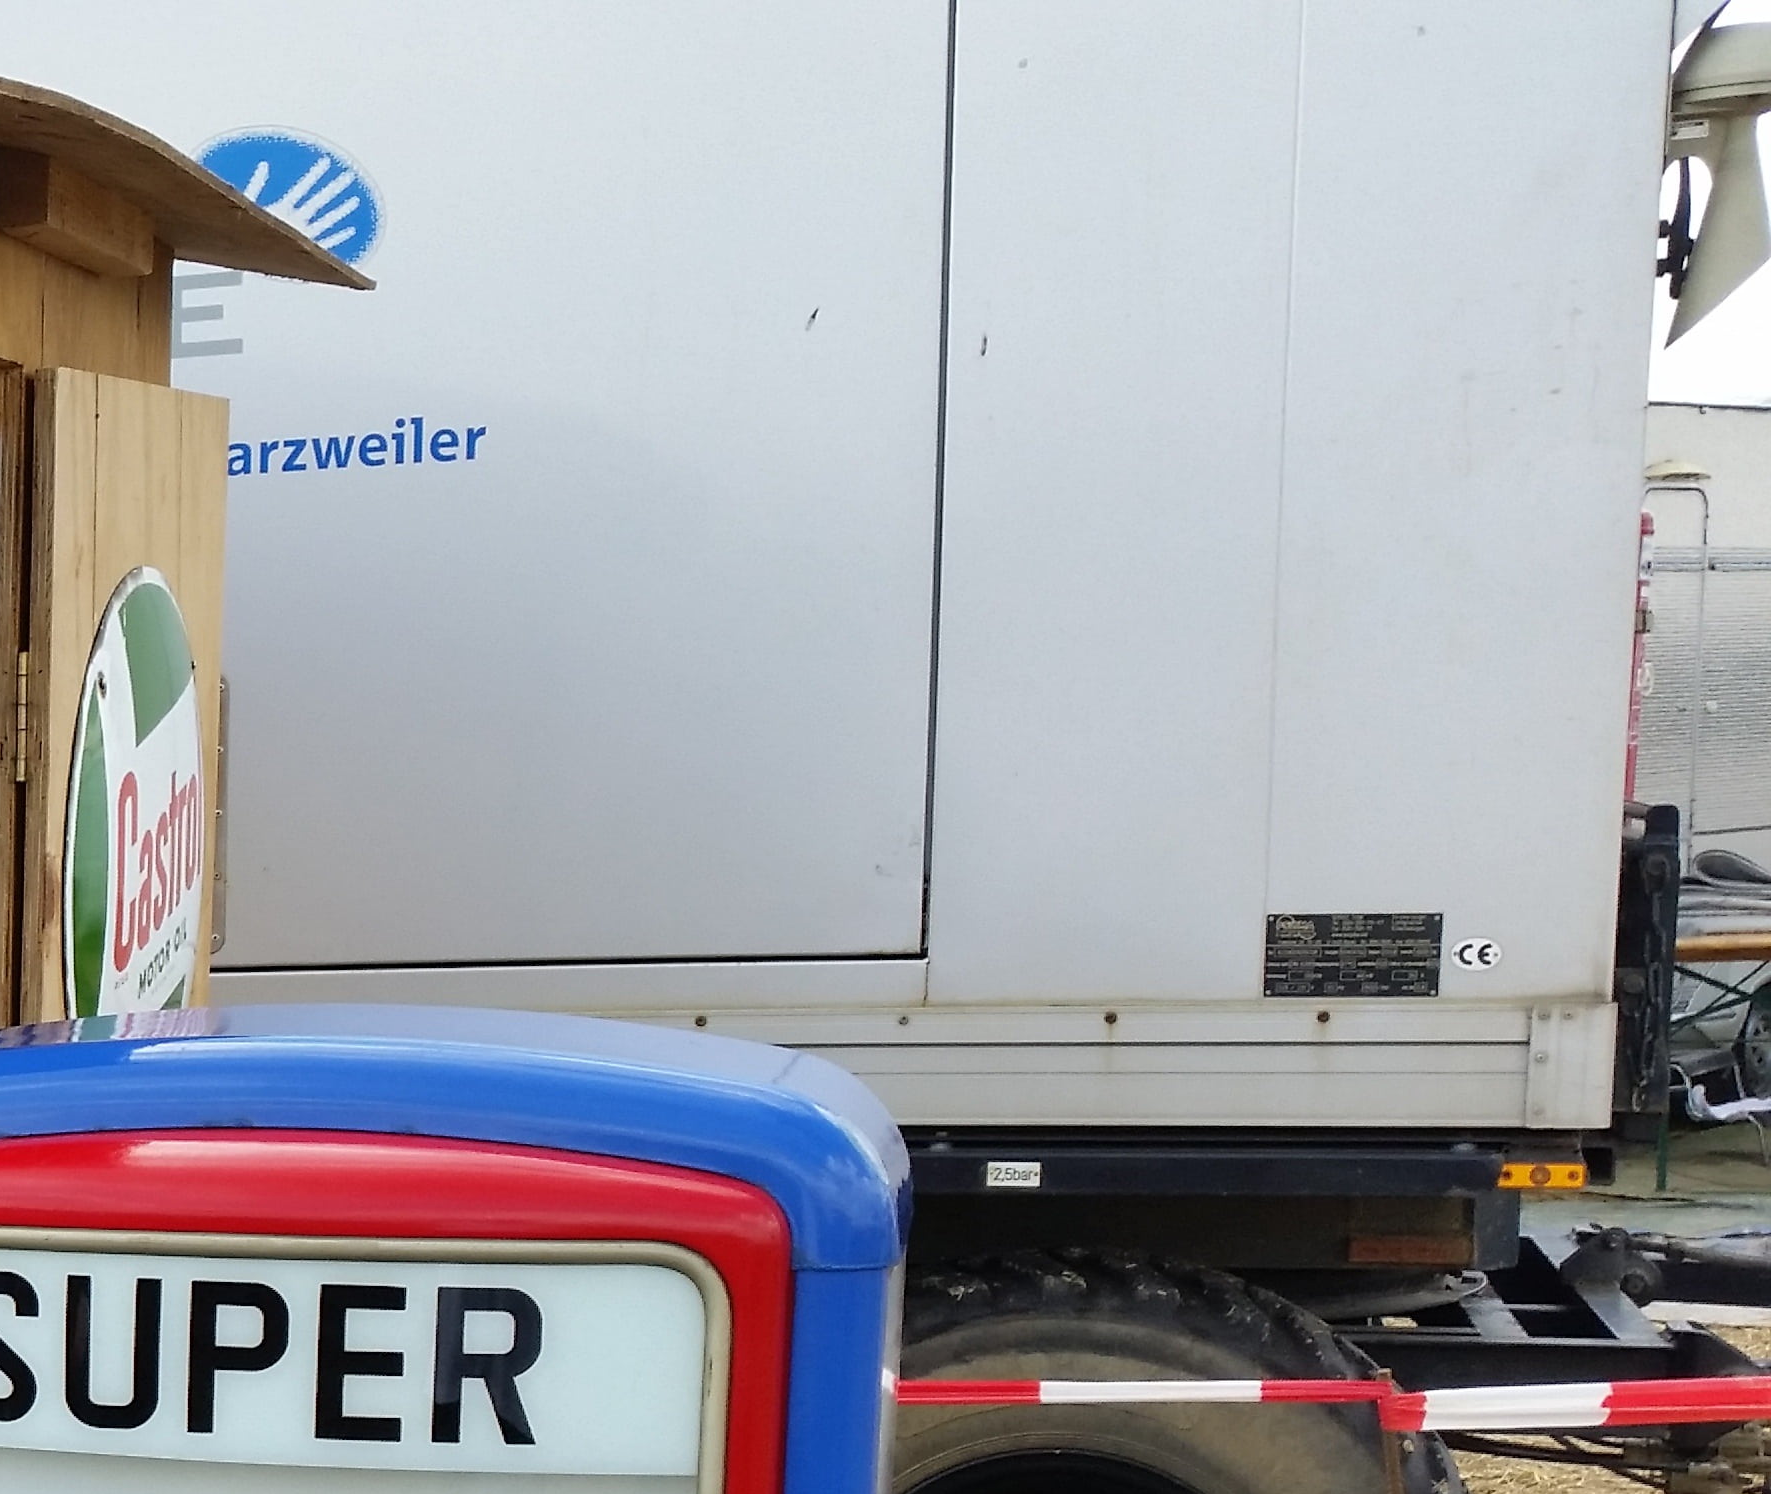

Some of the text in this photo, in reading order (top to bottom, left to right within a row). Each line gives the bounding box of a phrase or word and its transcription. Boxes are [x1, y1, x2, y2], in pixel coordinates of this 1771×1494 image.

[227, 415, 487, 477] arzweiler
[113, 770, 201, 973] Castrol
[138, 938, 171, 999] MOTOR
[993, 1167, 1033, 1181] 2,5bar
